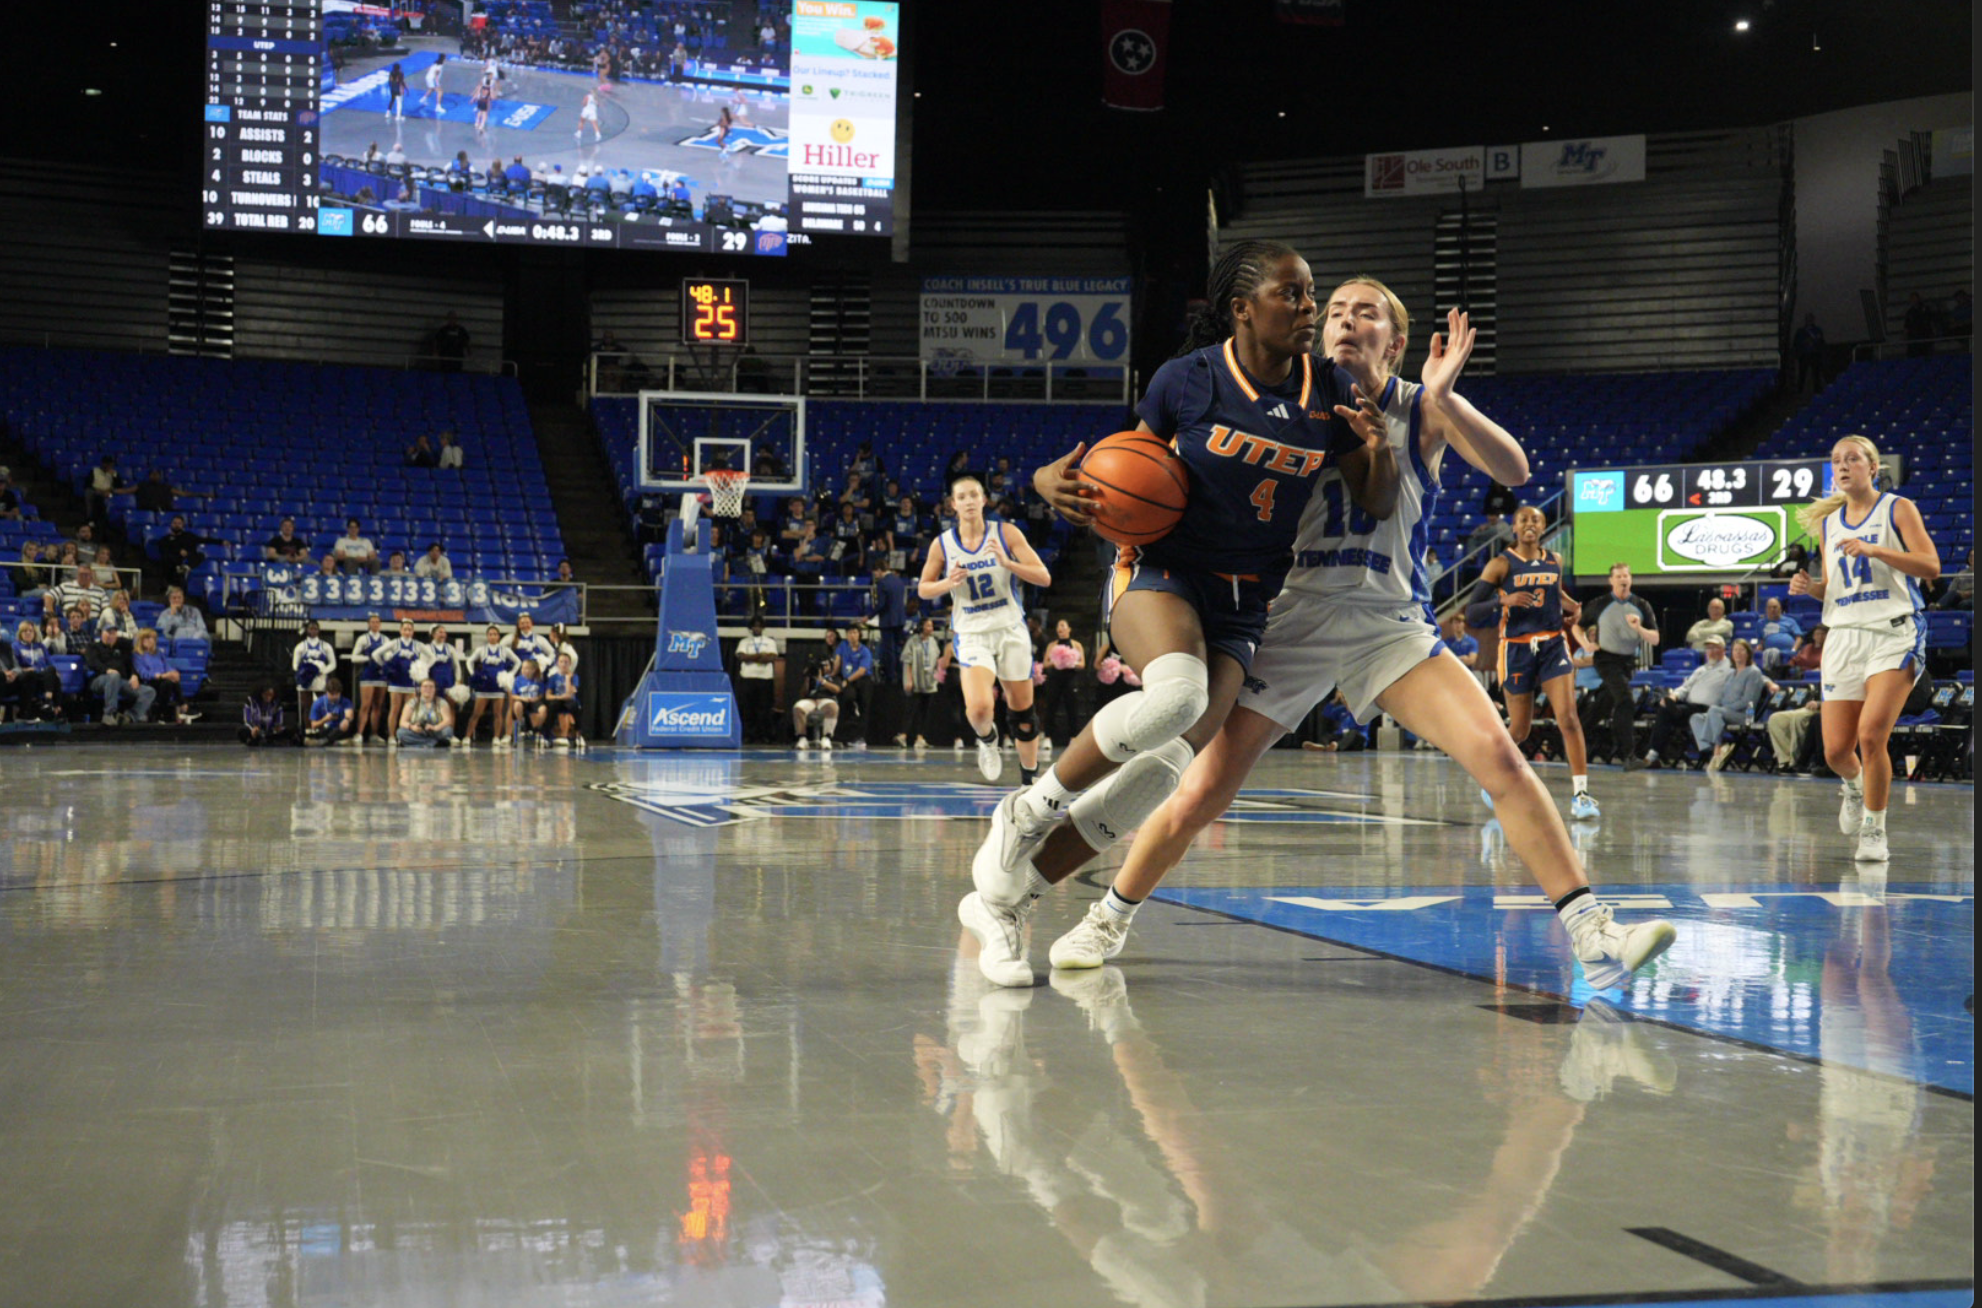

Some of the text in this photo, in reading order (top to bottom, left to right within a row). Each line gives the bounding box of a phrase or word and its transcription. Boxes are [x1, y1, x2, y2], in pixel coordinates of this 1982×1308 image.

[800, 1, 855, 16] You Win.
[253, 41, 275, 50] UTEP
[237, 109, 262, 120] TEAM
[263, 111, 289, 122] STATS
[209, 125, 313, 144] 10 ASSISTS 2
[212, 147, 312, 166] 2 BLOCKS 0
[803, 144, 880, 168] Hiller
[1406, 155, 1480, 174] Ole South
[1494, 152, 1511, 172] B
[1560, 143, 1608, 172] MT
[211, 169, 312, 187] 4 STEALS 3
[202, 190, 218, 204] 10
[230, 191, 291, 207] TURNOVERS
[792, 184, 889, 198] WOMEN'S BASKETBALL
[207, 212, 316, 230] 39 TOTAL REB 20
[361, 214, 389, 235] 66
[532, 224, 580, 241] 0:48.3
[722, 232, 747, 251] 29
[690, 285, 730, 304] 48.1
[924, 279, 1128, 291] COACH INSELL'S TRUE BLUE LEGACY
[923, 298, 995, 309] COUNTDOWN
[695, 304, 736, 338] 25
[923, 311, 968, 324] TO 500
[923, 326, 996, 340] MTSU WINS
[1004, 302, 1129, 360] 496
[1206, 424, 1326, 478] UTEP
[1632, 474, 1674, 503] 66
[1697, 468, 1747, 490] 48.3
[1771, 468, 1815, 499] 29
[1249, 478, 1279, 522] 4
[1707, 491, 1733, 504] 3RD
[1695, 542, 1754, 555] DRUGS
[1296, 548, 1393, 575] TENNESSEE
[1838, 552, 1873, 588] 14
[966, 573, 995, 601] 12
[1513, 572, 1559, 587] UTEP
[304, 577, 319, 600] 3
[326, 577, 340, 600] 3
[347, 578, 362, 600] 3
[369, 580, 384, 601] 3
[403, 581, 418, 602] 3
[422, 581, 436, 602] 3
[447, 582, 461, 602] 3
[473, 582, 487, 603] 3
[667, 630, 707, 659] MT
[653, 708, 727, 725] Ascend
